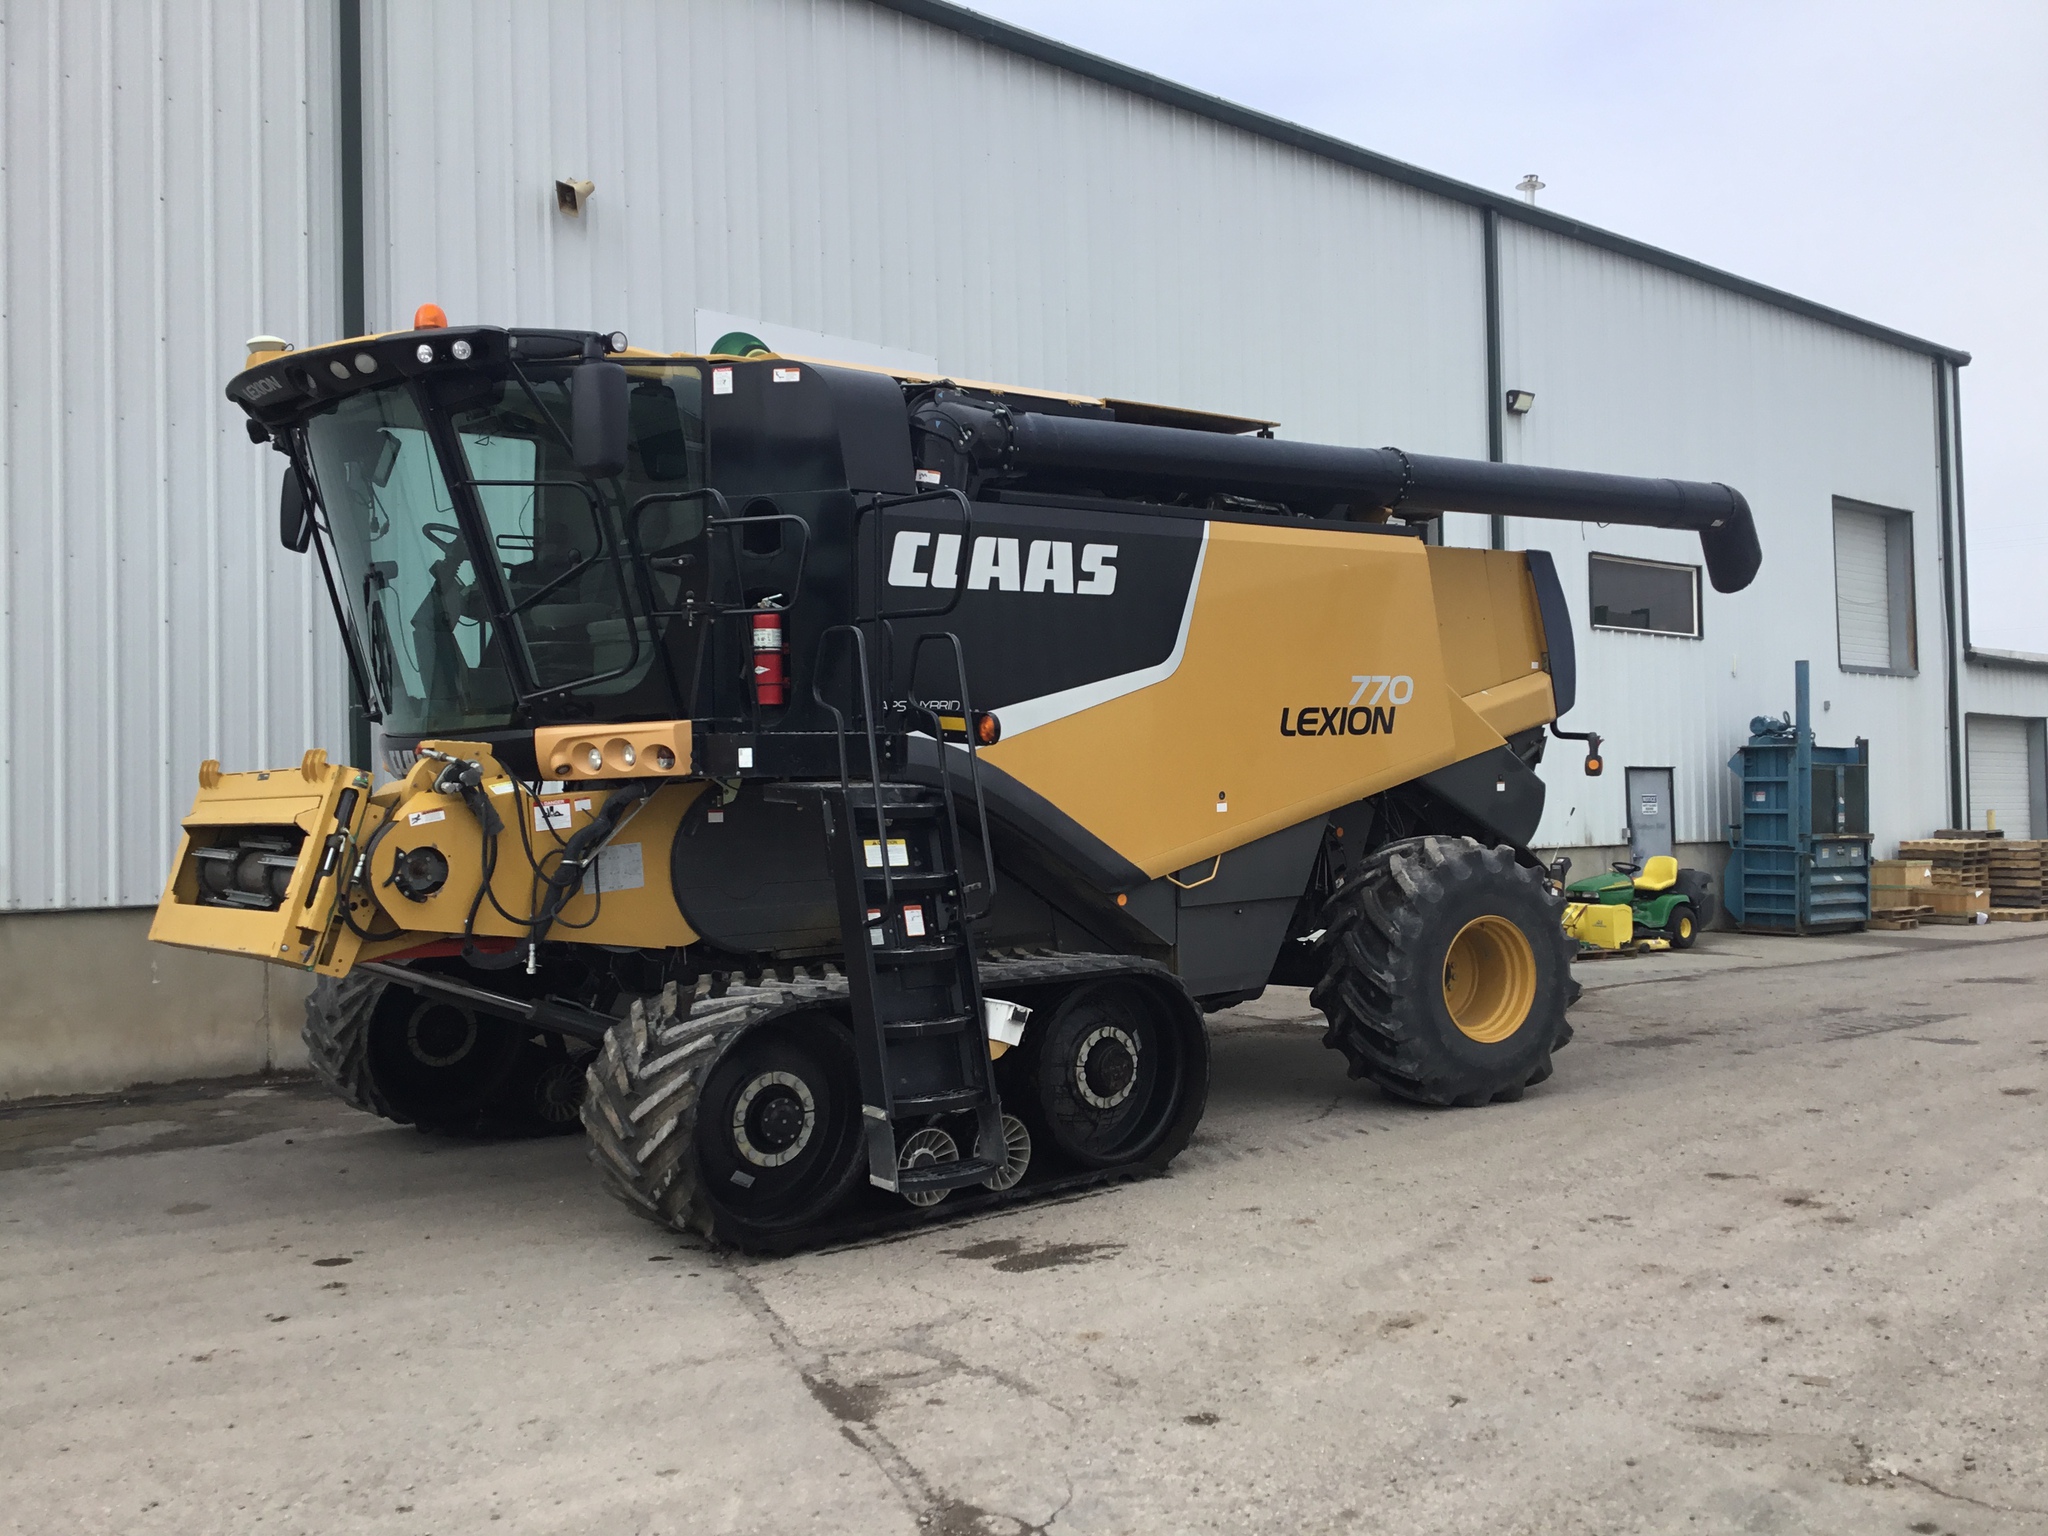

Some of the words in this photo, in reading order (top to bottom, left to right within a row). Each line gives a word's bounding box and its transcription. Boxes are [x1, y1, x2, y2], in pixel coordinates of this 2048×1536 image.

[242, 375, 282, 400] LEXION
[887, 530, 1118, 596] CLAAS
[1349, 675, 1414, 705] 770
[1280, 706, 1395, 736] LEXION
